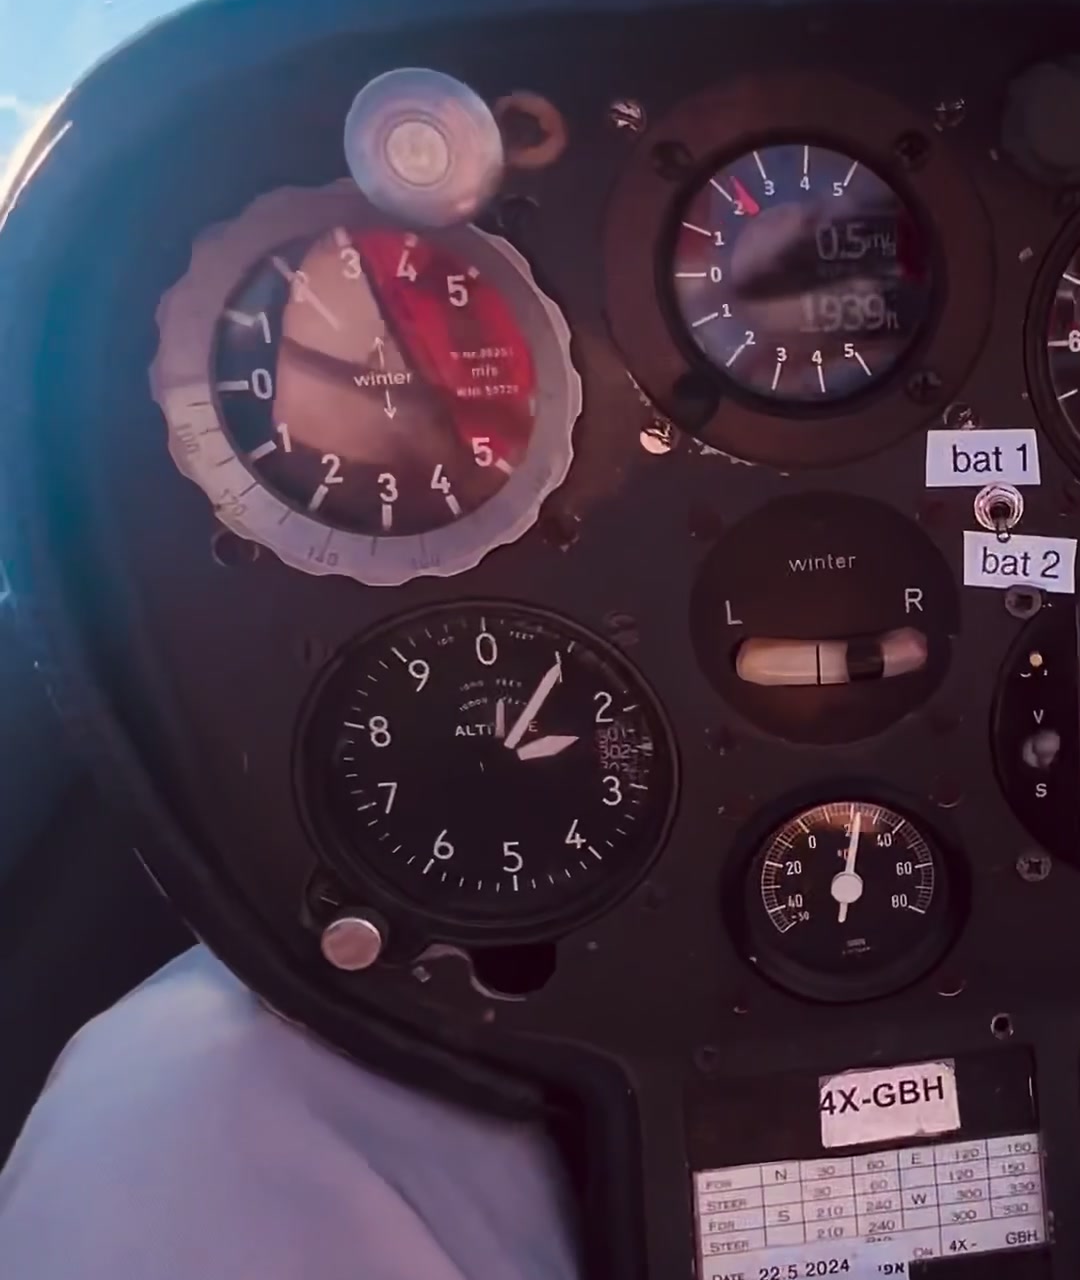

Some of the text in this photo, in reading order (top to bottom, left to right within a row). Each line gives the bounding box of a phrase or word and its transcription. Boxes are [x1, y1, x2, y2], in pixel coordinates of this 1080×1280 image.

[764, 180, 775, 196] 3
[800, 176, 811, 191] 4
[833, 182, 843, 197] 5
[733, 201, 745, 216] 2
[714, 231, 725, 246] 1
[340, 248, 362, 280] 3
[396, 250, 418, 282] 4
[711, 267, 722, 283] 0
[447, 274, 469, 307] 5
[722, 303, 732, 318] 1
[257, 312, 272, 344] 1
[745, 330, 756, 346] 2
[776, 347, 787, 362] 3
[811, 350, 823, 365] 4
[844, 343, 854, 358] 5
[252, 369, 273, 399] 0
[353, 370, 413, 388] winter
[277, 423, 292, 452] 1
[472, 437, 493, 467] 5
[952, 443, 1028, 473] bat 1
[321, 454, 343, 484] 2
[431, 464, 451, 494] 4
[377, 473, 398, 502] 3
[788, 554, 856, 572] winter
[982, 547, 1060, 579] bat 2
[725, 600, 743, 625] L
[904, 588, 923, 613] R
[476, 632, 497, 665] 0
[408, 659, 430, 692] 9
[594, 691, 613, 722] 2
[1033, 709, 1044, 724] V
[369, 716, 391, 747] 8
[377, 782, 397, 814] 7
[602, 776, 622, 806] 3
[1035, 783, 1048, 797] S
[433, 829, 454, 860] 6
[565, 819, 586, 848] 4
[808, 835, 816, 848] 0
[877, 833, 892, 847] 40
[503, 841, 523, 872] 5
[786, 861, 801, 875] 20
[896, 862, 912, 875] 60
[788, 894, 802, 907] 40
[892, 894, 907, 908] 80
[820, 1076, 944, 1116] 4X-GBH
[775, 1170, 788, 1181] N
[867, 1160, 885, 1170] 60
[911, 1153, 921, 1165] E
[706, 1198, 747, 1212] STEER
[870, 1180, 888, 1191] 60
[708, 1221, 735, 1232] FOR
[777, 1210, 790, 1222] S
[816, 1206, 844, 1219] 210
[911, 1193, 927, 1205] W
[710, 1240, 749, 1253] STEER
[817, 1227, 844, 1239] 210
[869, 1220, 895, 1233] 240
[951, 1209, 977, 1222] 300
[1005, 1230, 1038, 1245] GBH
